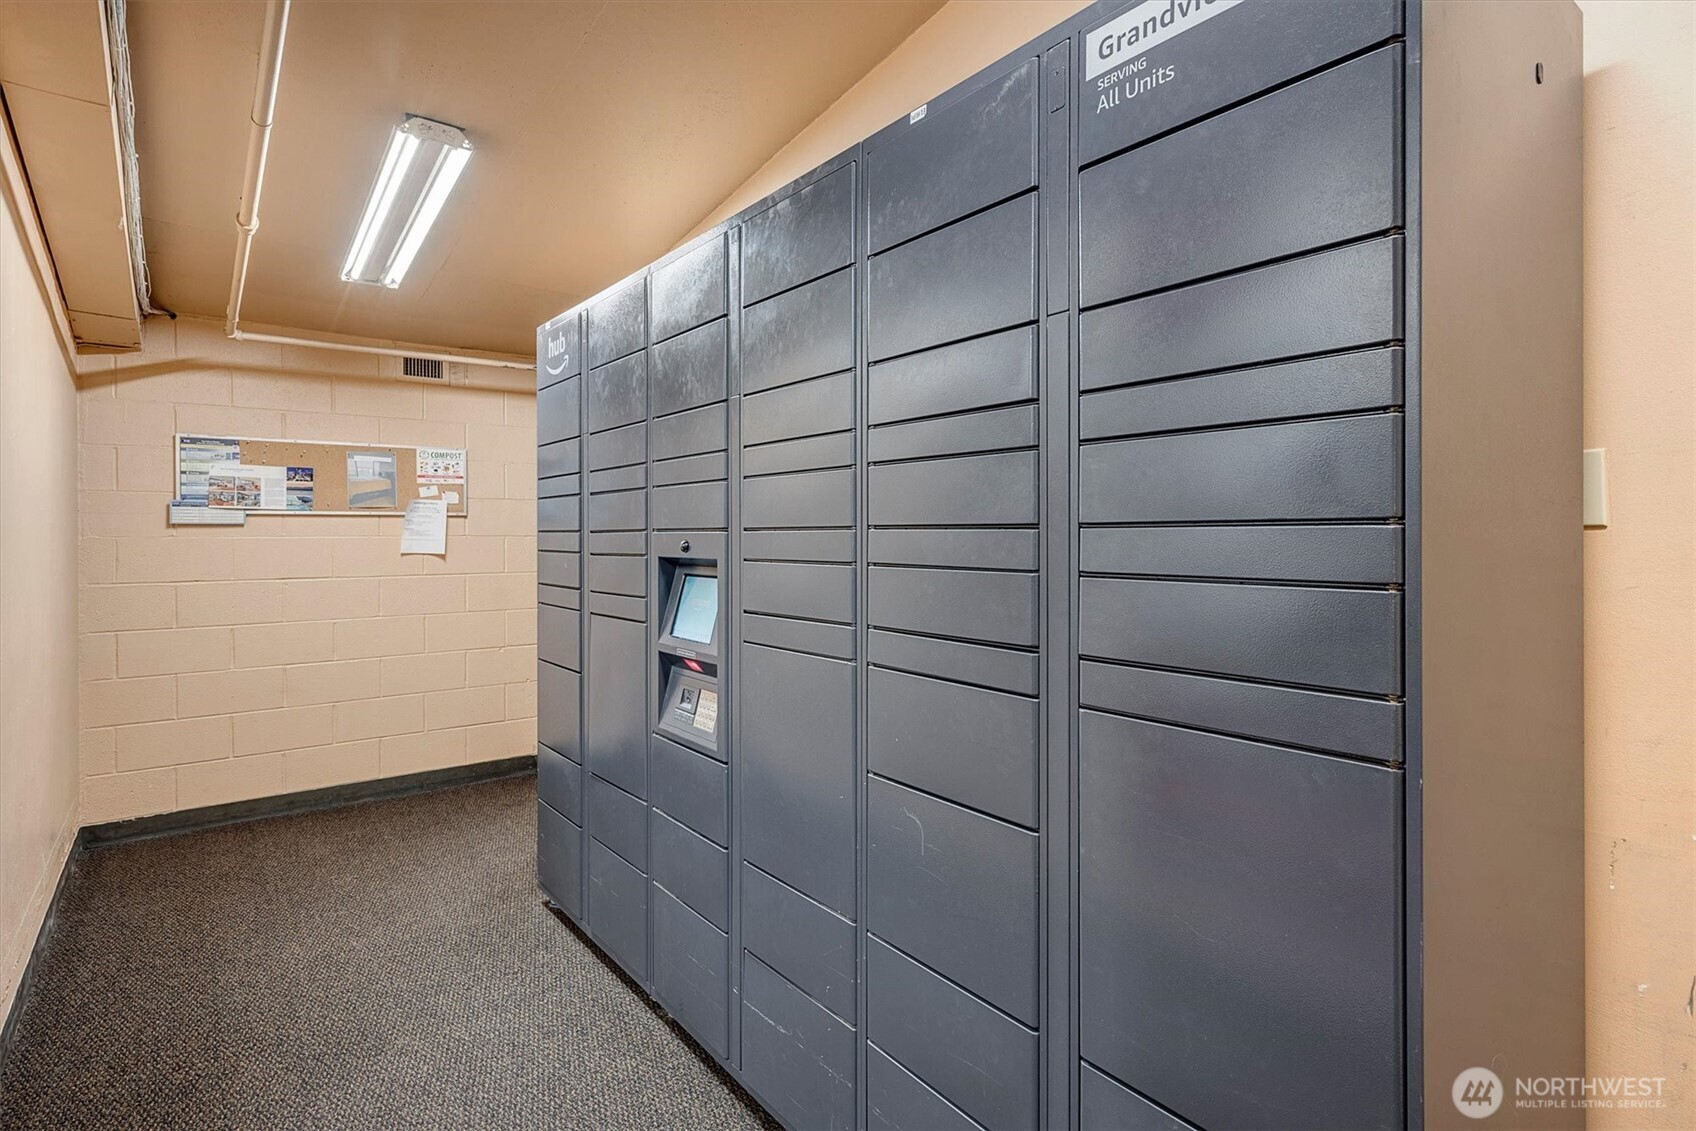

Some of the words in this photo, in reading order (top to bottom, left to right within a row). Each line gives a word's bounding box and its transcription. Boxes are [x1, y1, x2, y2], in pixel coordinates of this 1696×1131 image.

[1098, 0, 1217, 60] Grandvi
[1096, 85, 1120, 114] All
[1125, 65, 1175, 99] Units
[1097, 57, 1147, 91] SERVING
[548, 331, 566, 359] hub
[430, 452, 462, 460] COMPOST
